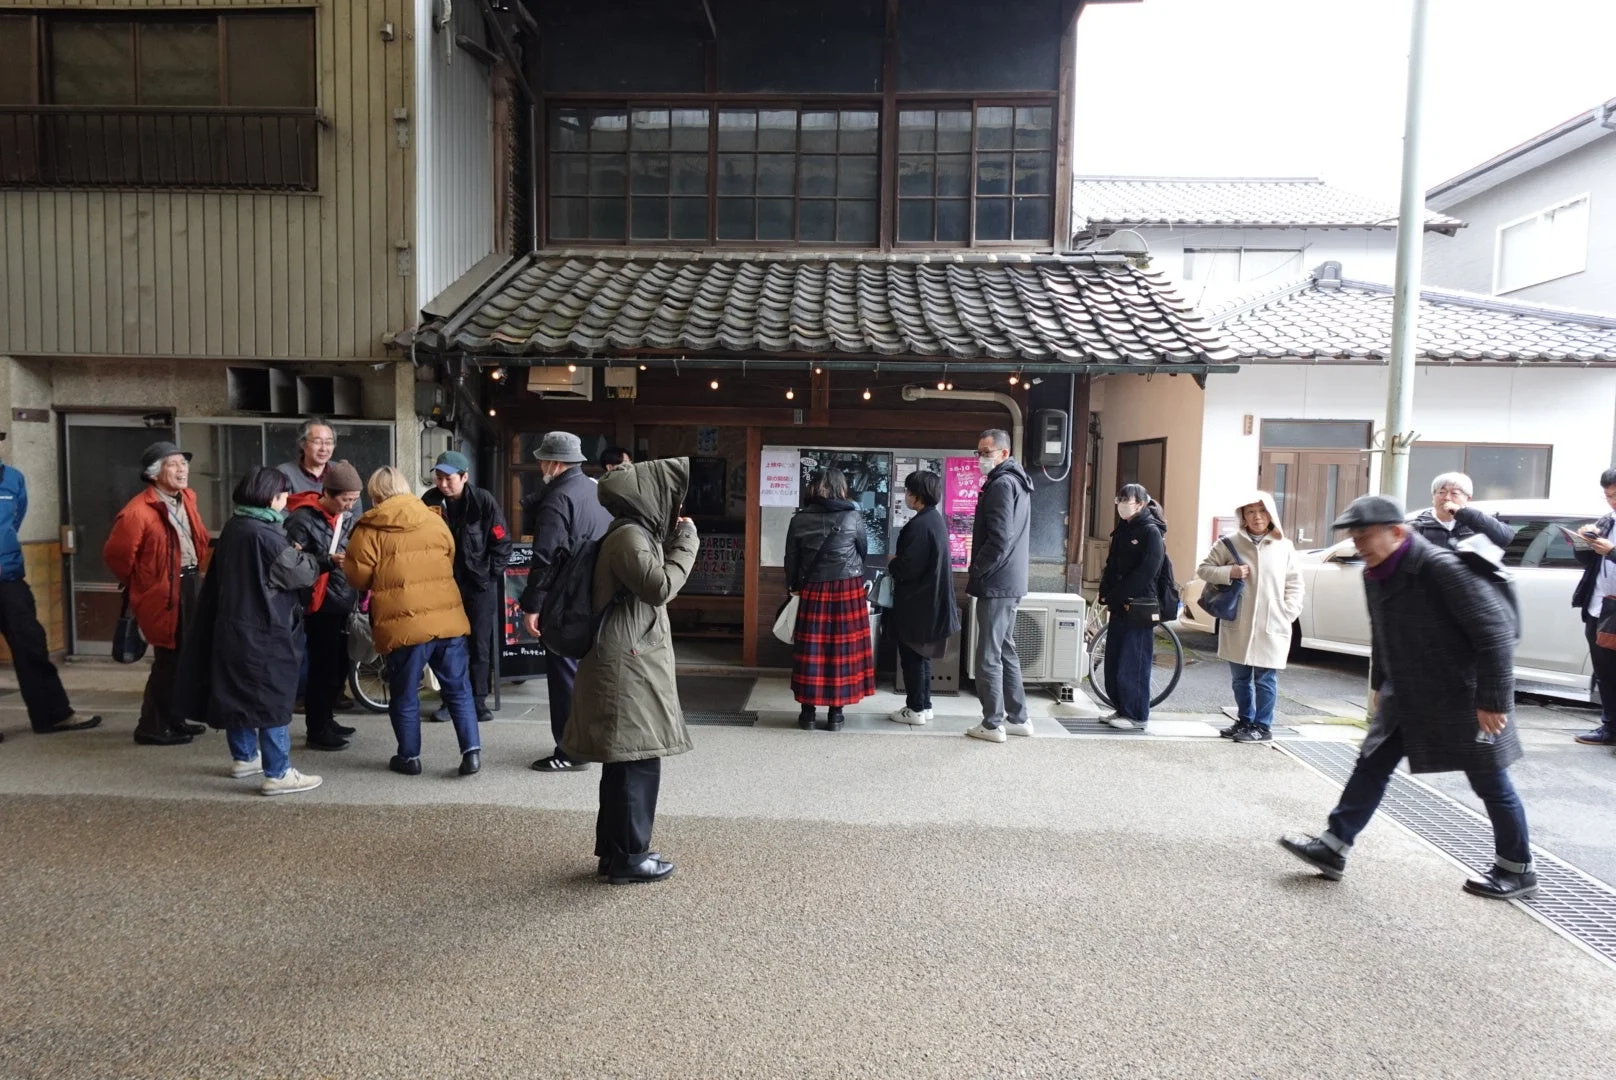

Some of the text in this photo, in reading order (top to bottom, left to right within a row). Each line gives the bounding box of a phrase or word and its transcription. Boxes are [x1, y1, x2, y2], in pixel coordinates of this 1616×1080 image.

[700, 538, 738, 548] GARDEN
[701, 550, 744, 560] FESTIVA
[694, 561, 726, 572] 2024
